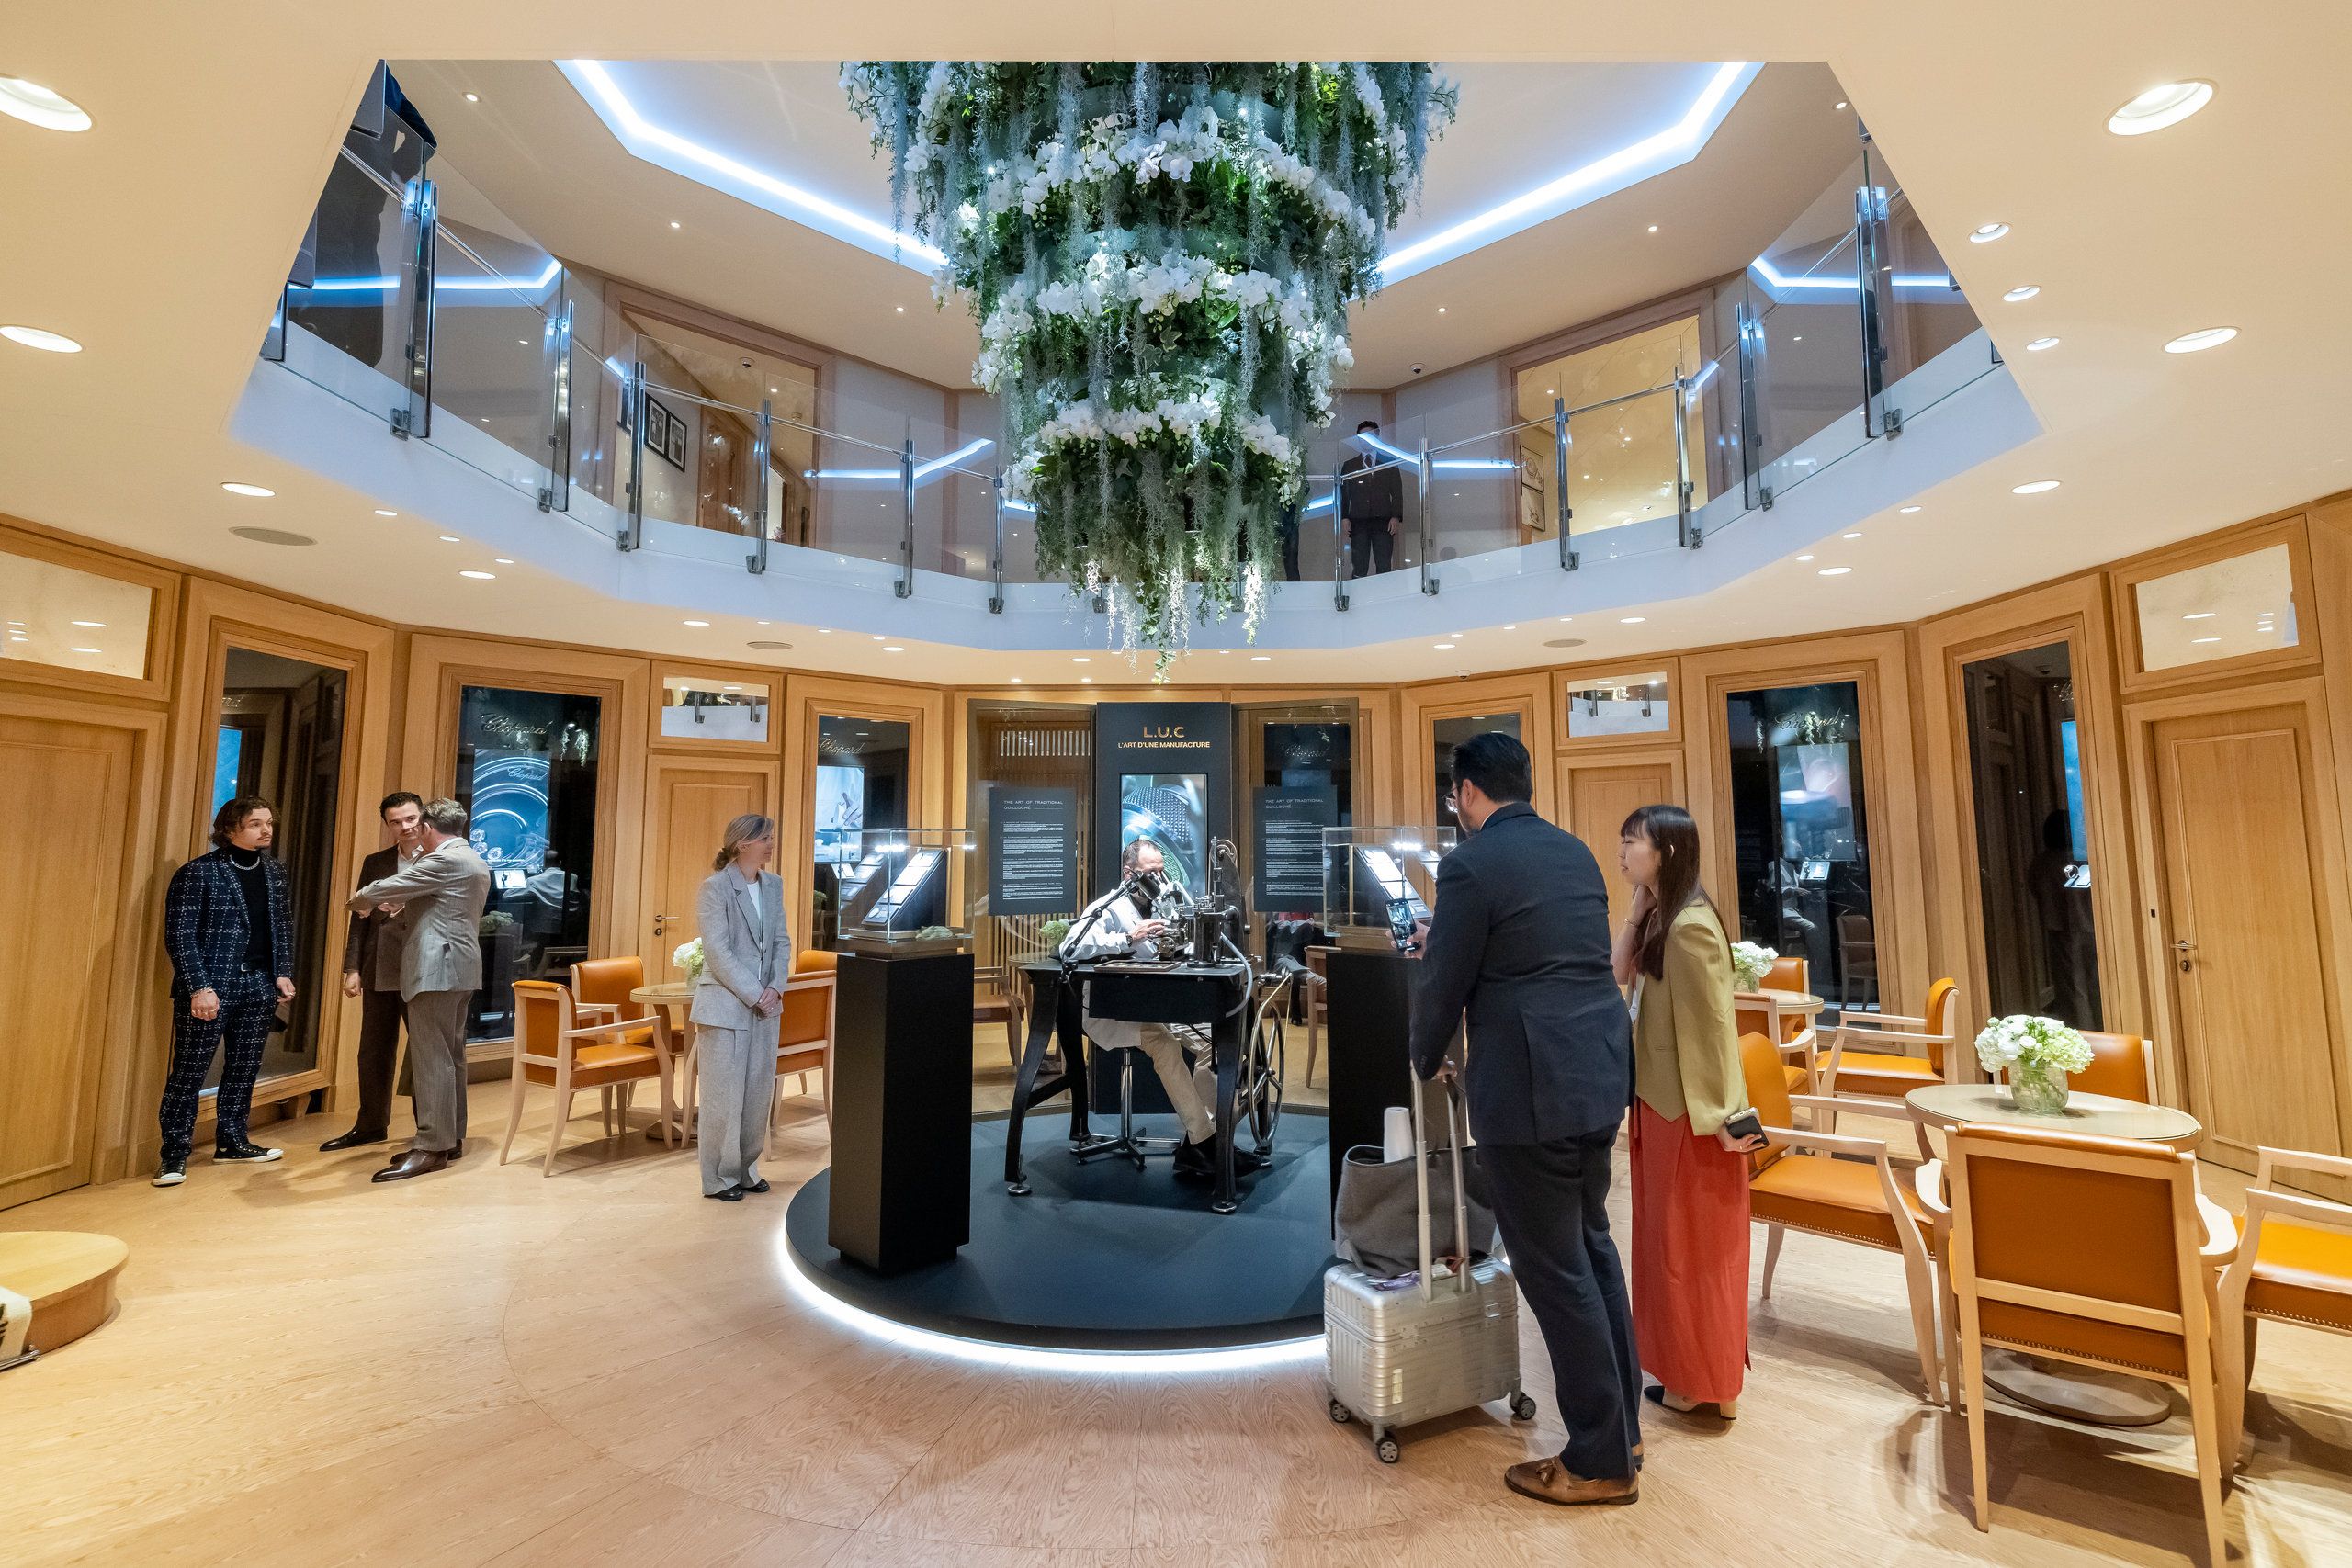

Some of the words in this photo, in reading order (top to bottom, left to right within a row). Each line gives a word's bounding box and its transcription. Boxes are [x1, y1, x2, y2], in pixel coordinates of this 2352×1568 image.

[480, 713, 553, 736] Chopard
[1775, 706, 1840, 730] Choard
[1143, 726, 1184, 738] L.U.C
[817, 737, 866, 756] Chopard
[507, 764, 548, 781] Chopard
